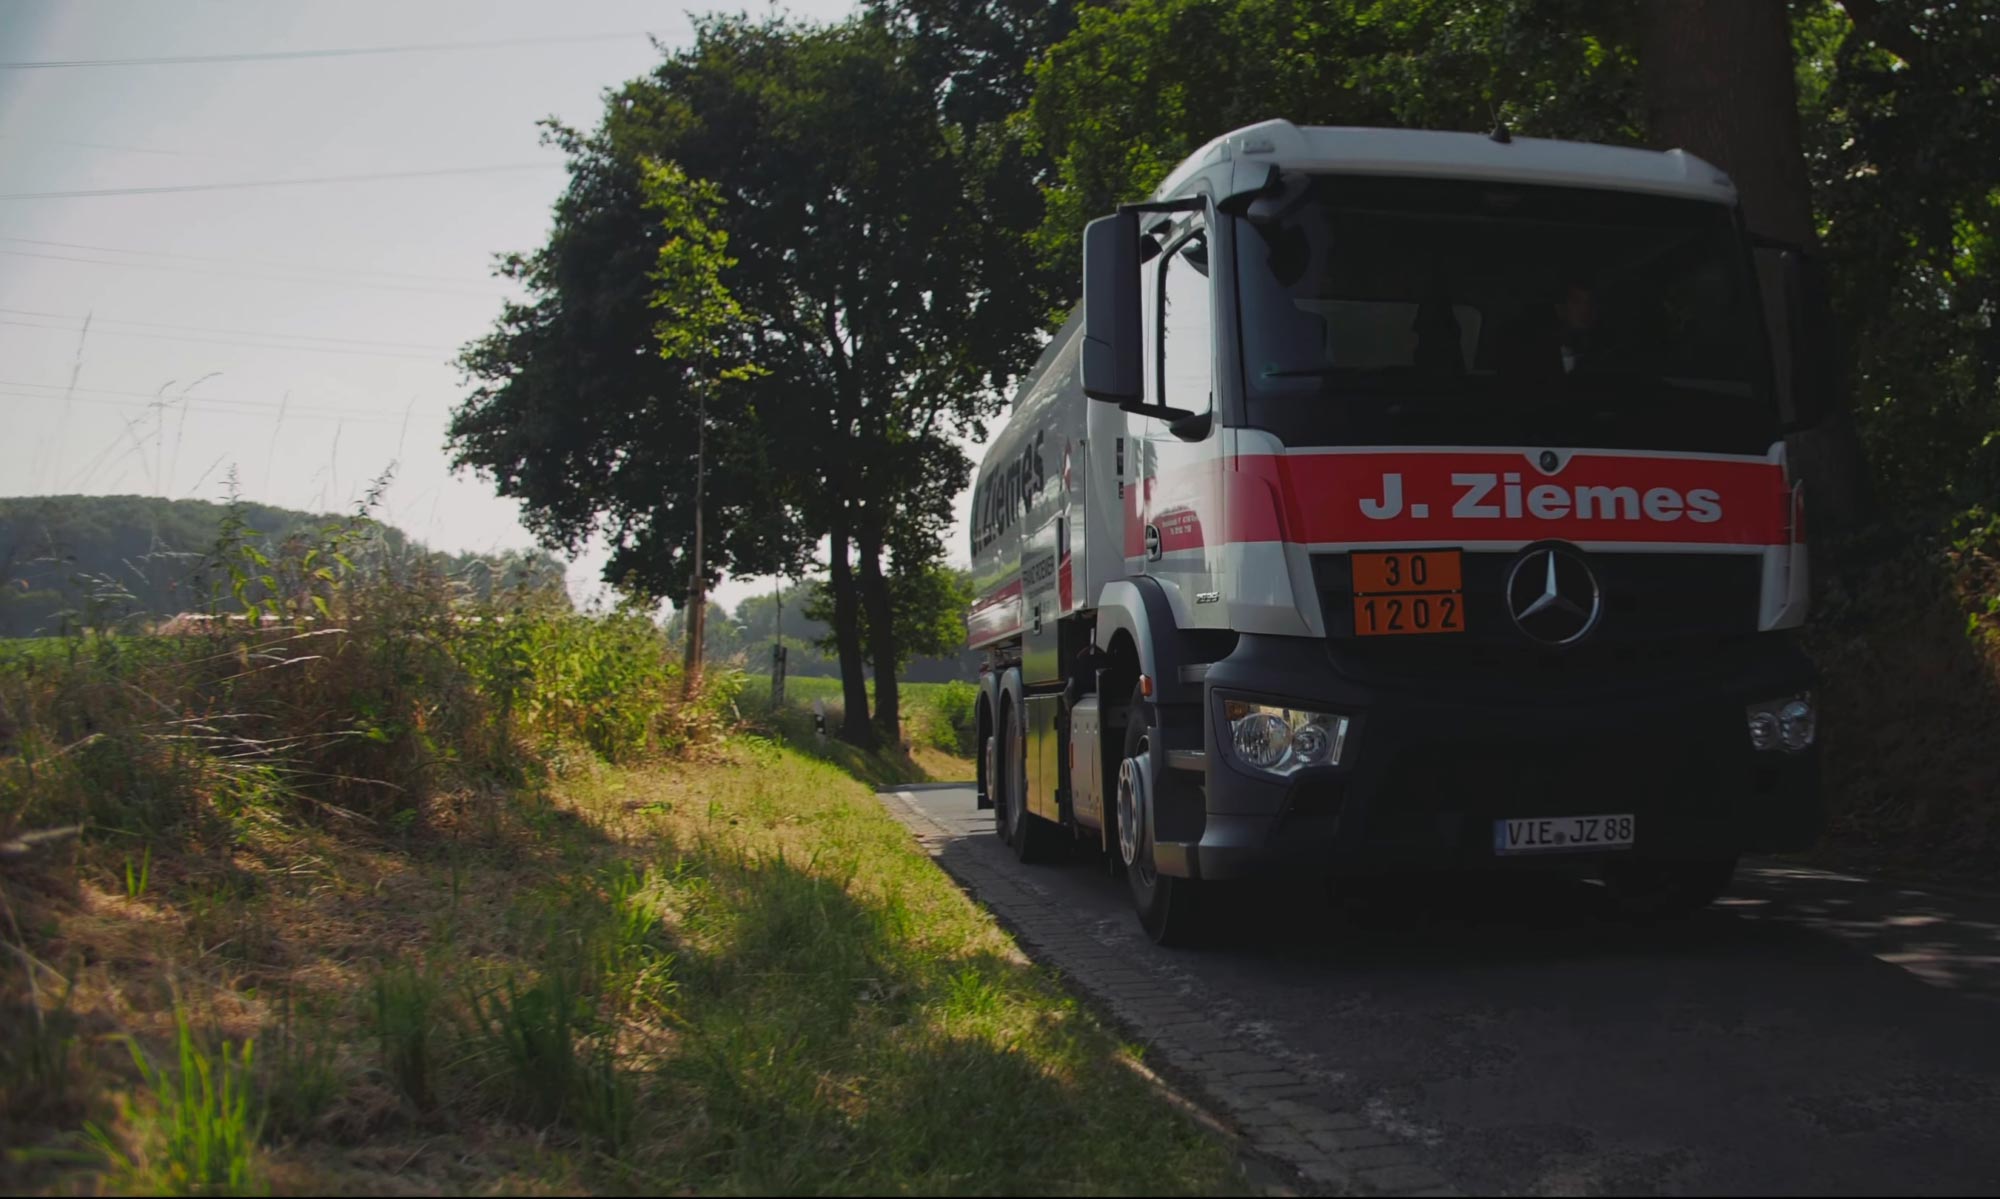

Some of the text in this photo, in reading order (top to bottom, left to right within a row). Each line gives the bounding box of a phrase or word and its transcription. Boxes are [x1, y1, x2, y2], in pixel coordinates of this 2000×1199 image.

[1358, 472, 1723, 523] J. Ziemes
[1384, 555, 1428, 586] 30
[1363, 597, 1458, 631] 1202
[1508, 821, 1553, 845] VIE
